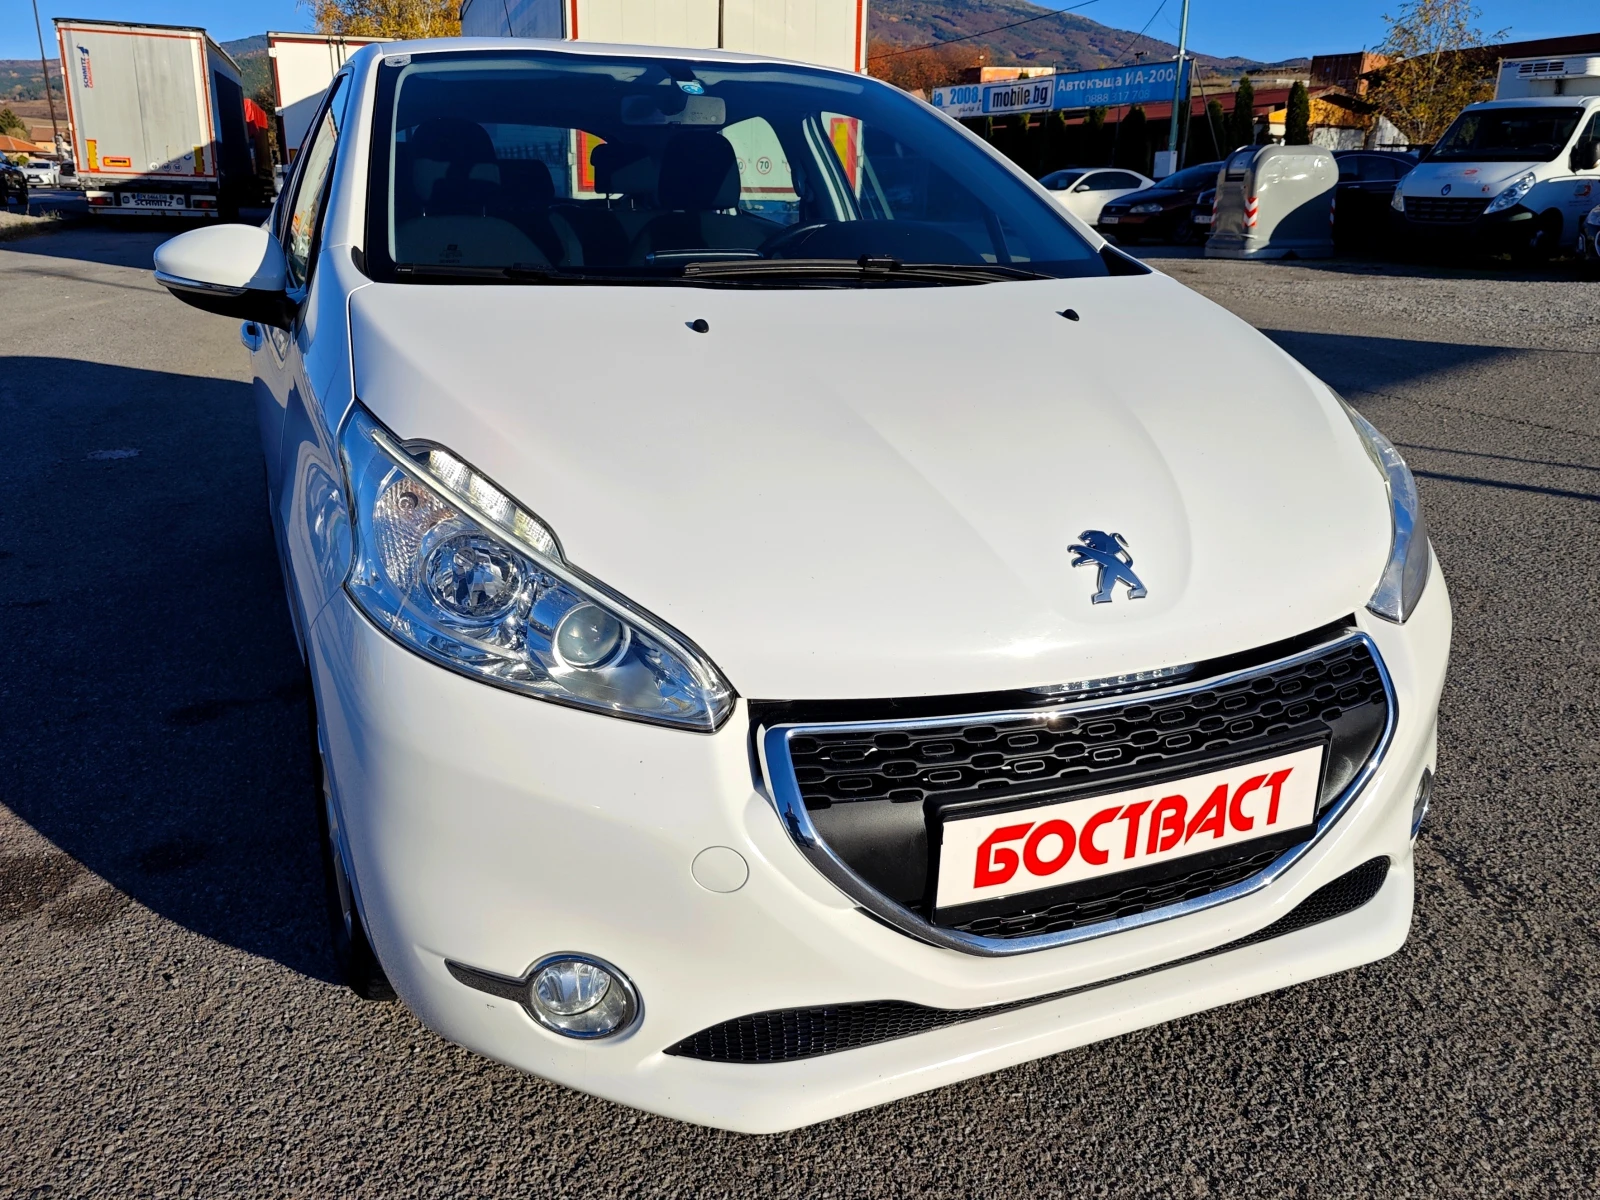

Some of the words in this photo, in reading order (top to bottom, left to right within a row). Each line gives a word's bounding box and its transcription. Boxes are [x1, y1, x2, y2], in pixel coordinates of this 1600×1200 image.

[81, 57, 89, 88] SCHMITZ
[1058, 76, 1122, 91] Автокъща
[992, 85, 1049, 108] mobile.bg
[1085, 92, 1109, 104] 0888
[1111, 91, 1130, 102] 317
[760, 161, 769, 170] 70
[134, 199, 173, 207] SCHMITZ
